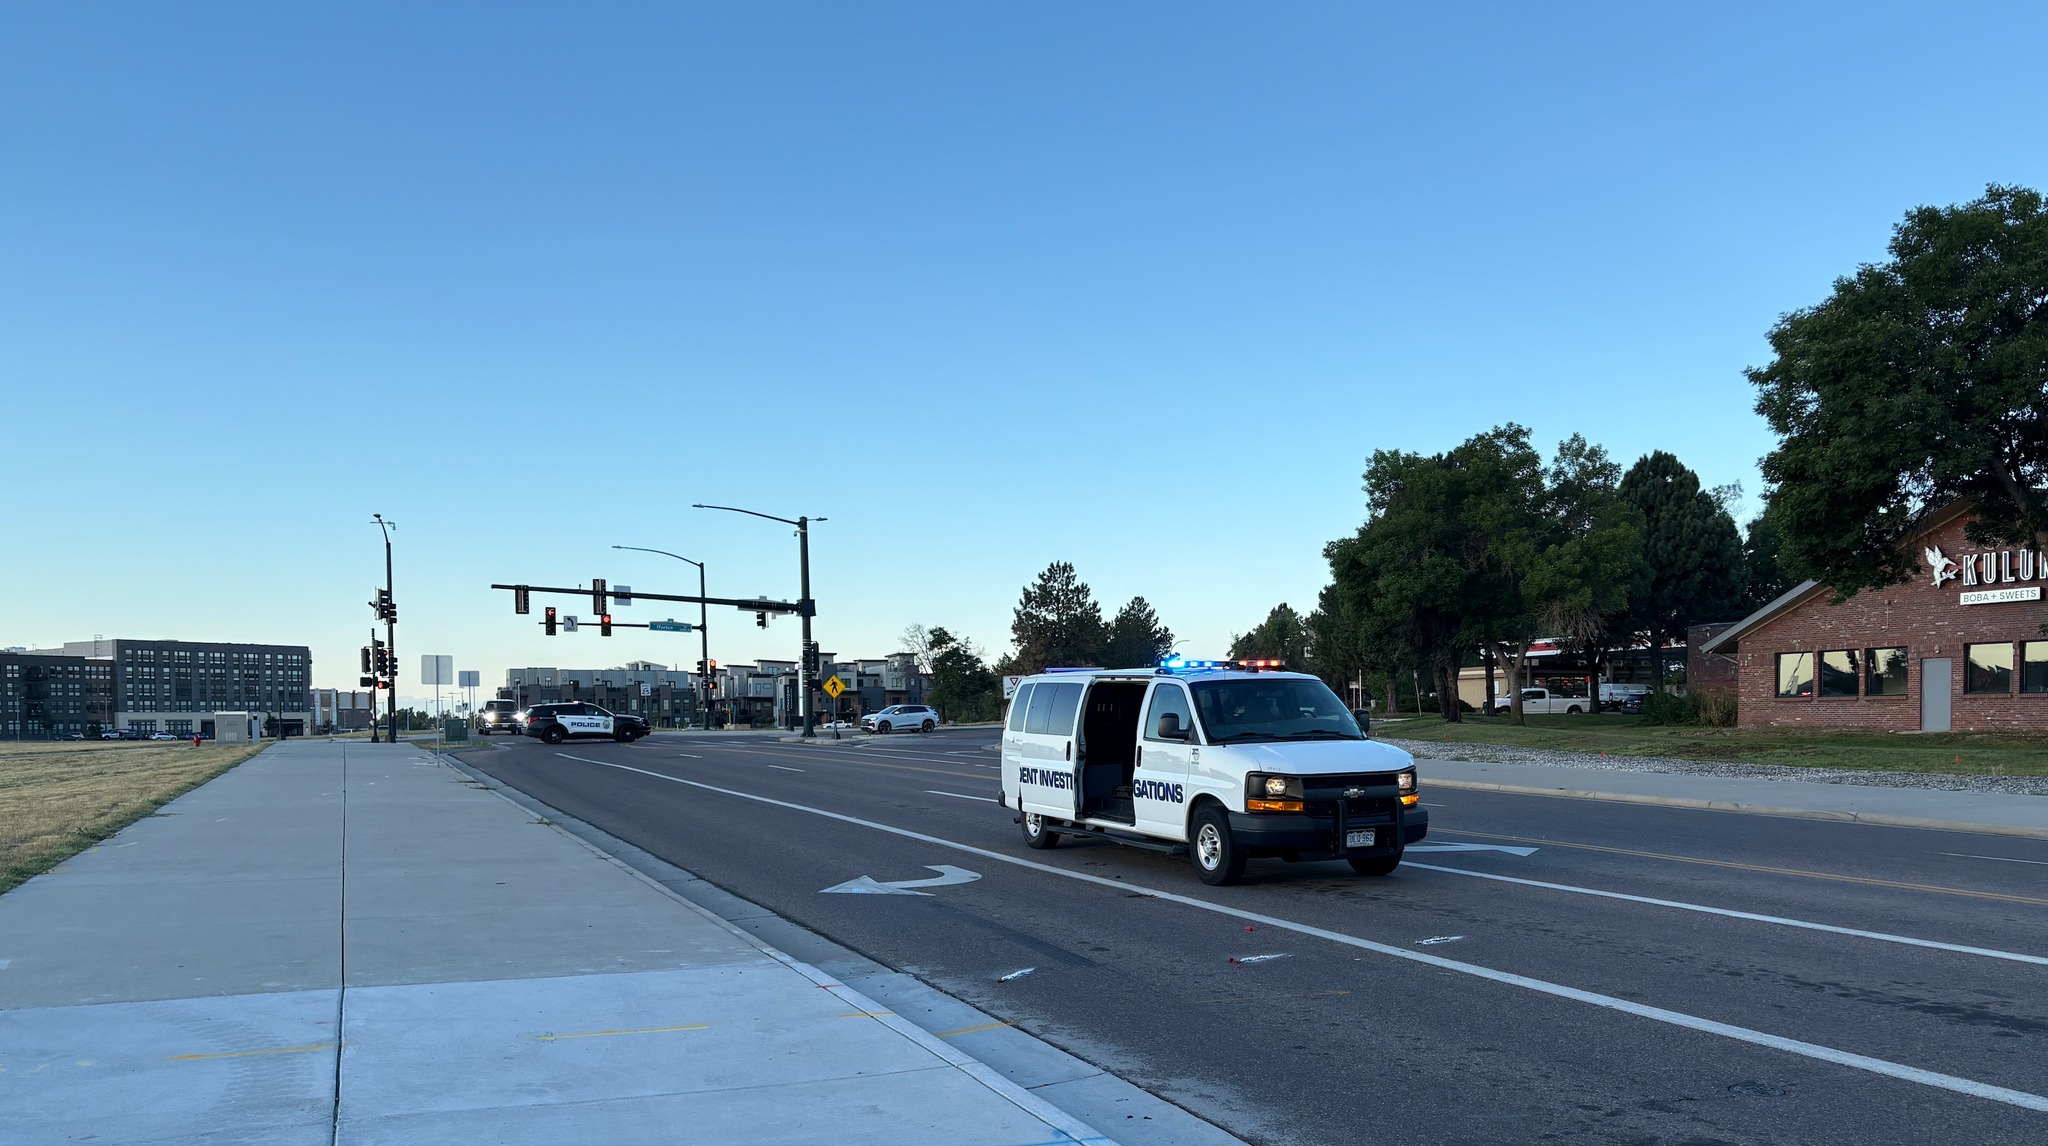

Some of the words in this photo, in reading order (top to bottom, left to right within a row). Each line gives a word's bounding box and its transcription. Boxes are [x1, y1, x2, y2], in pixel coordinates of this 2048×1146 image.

[1963, 594, 1989, 602] BOBA
[1999, 590, 2037, 601] SWEETS
[1039, 769, 1073, 790] INVESTI
[1133, 779, 1184, 803] GATIONS
